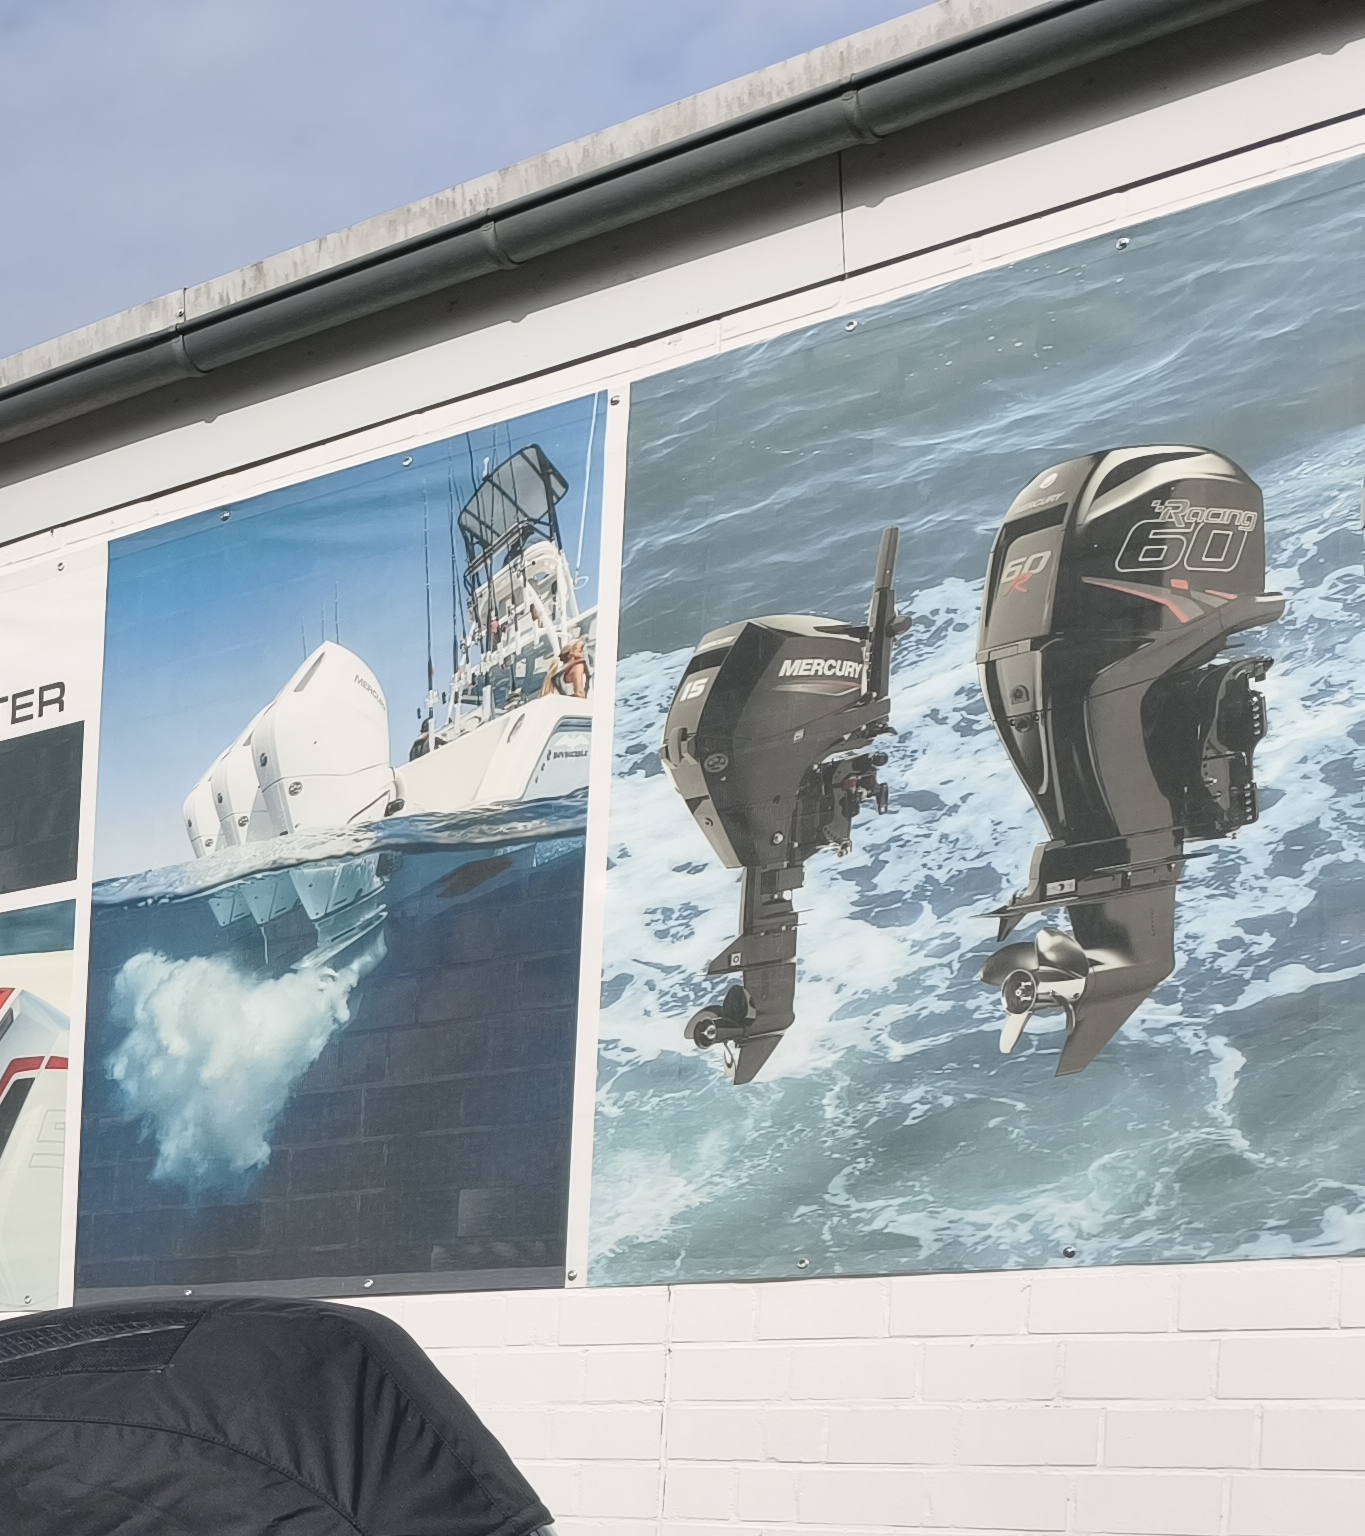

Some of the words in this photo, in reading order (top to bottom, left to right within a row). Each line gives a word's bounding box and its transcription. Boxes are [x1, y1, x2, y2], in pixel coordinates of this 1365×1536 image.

[1158, 499, 1258, 532] Racing
[1114, 519, 1248, 573] 60
[1001, 550, 1052, 584] 60
[778, 658, 864, 678] MERCURY
[680, 676, 710, 702] 15
